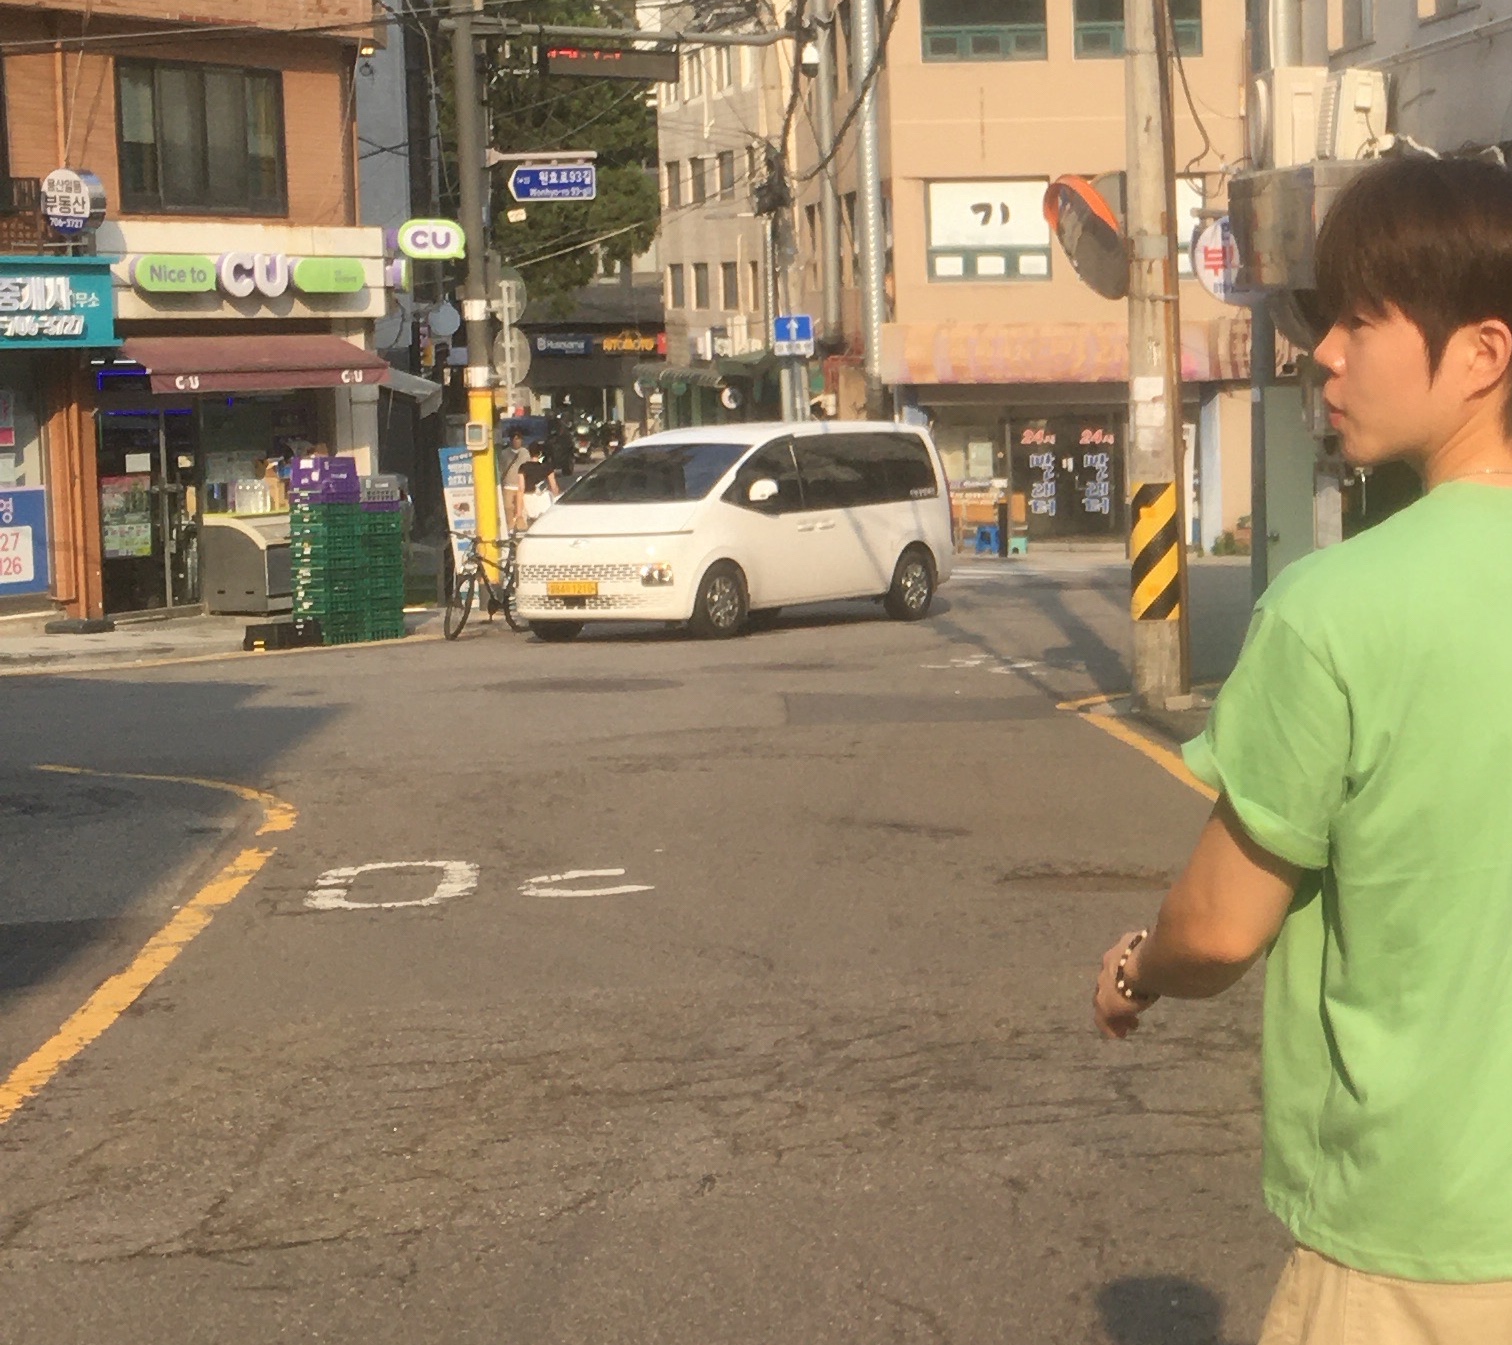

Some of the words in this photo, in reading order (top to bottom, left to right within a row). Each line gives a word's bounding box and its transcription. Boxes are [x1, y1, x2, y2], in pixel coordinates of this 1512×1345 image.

[45, 195, 86, 215] 부동산
[410, 230, 451, 249] CU
[149, 263, 186, 283] Nice
[189, 265, 207, 284] to
[219, 252, 289, 298] CU
[1021, 428, 1056, 445] 24시
[1079, 428, 1115, 445] 24시
